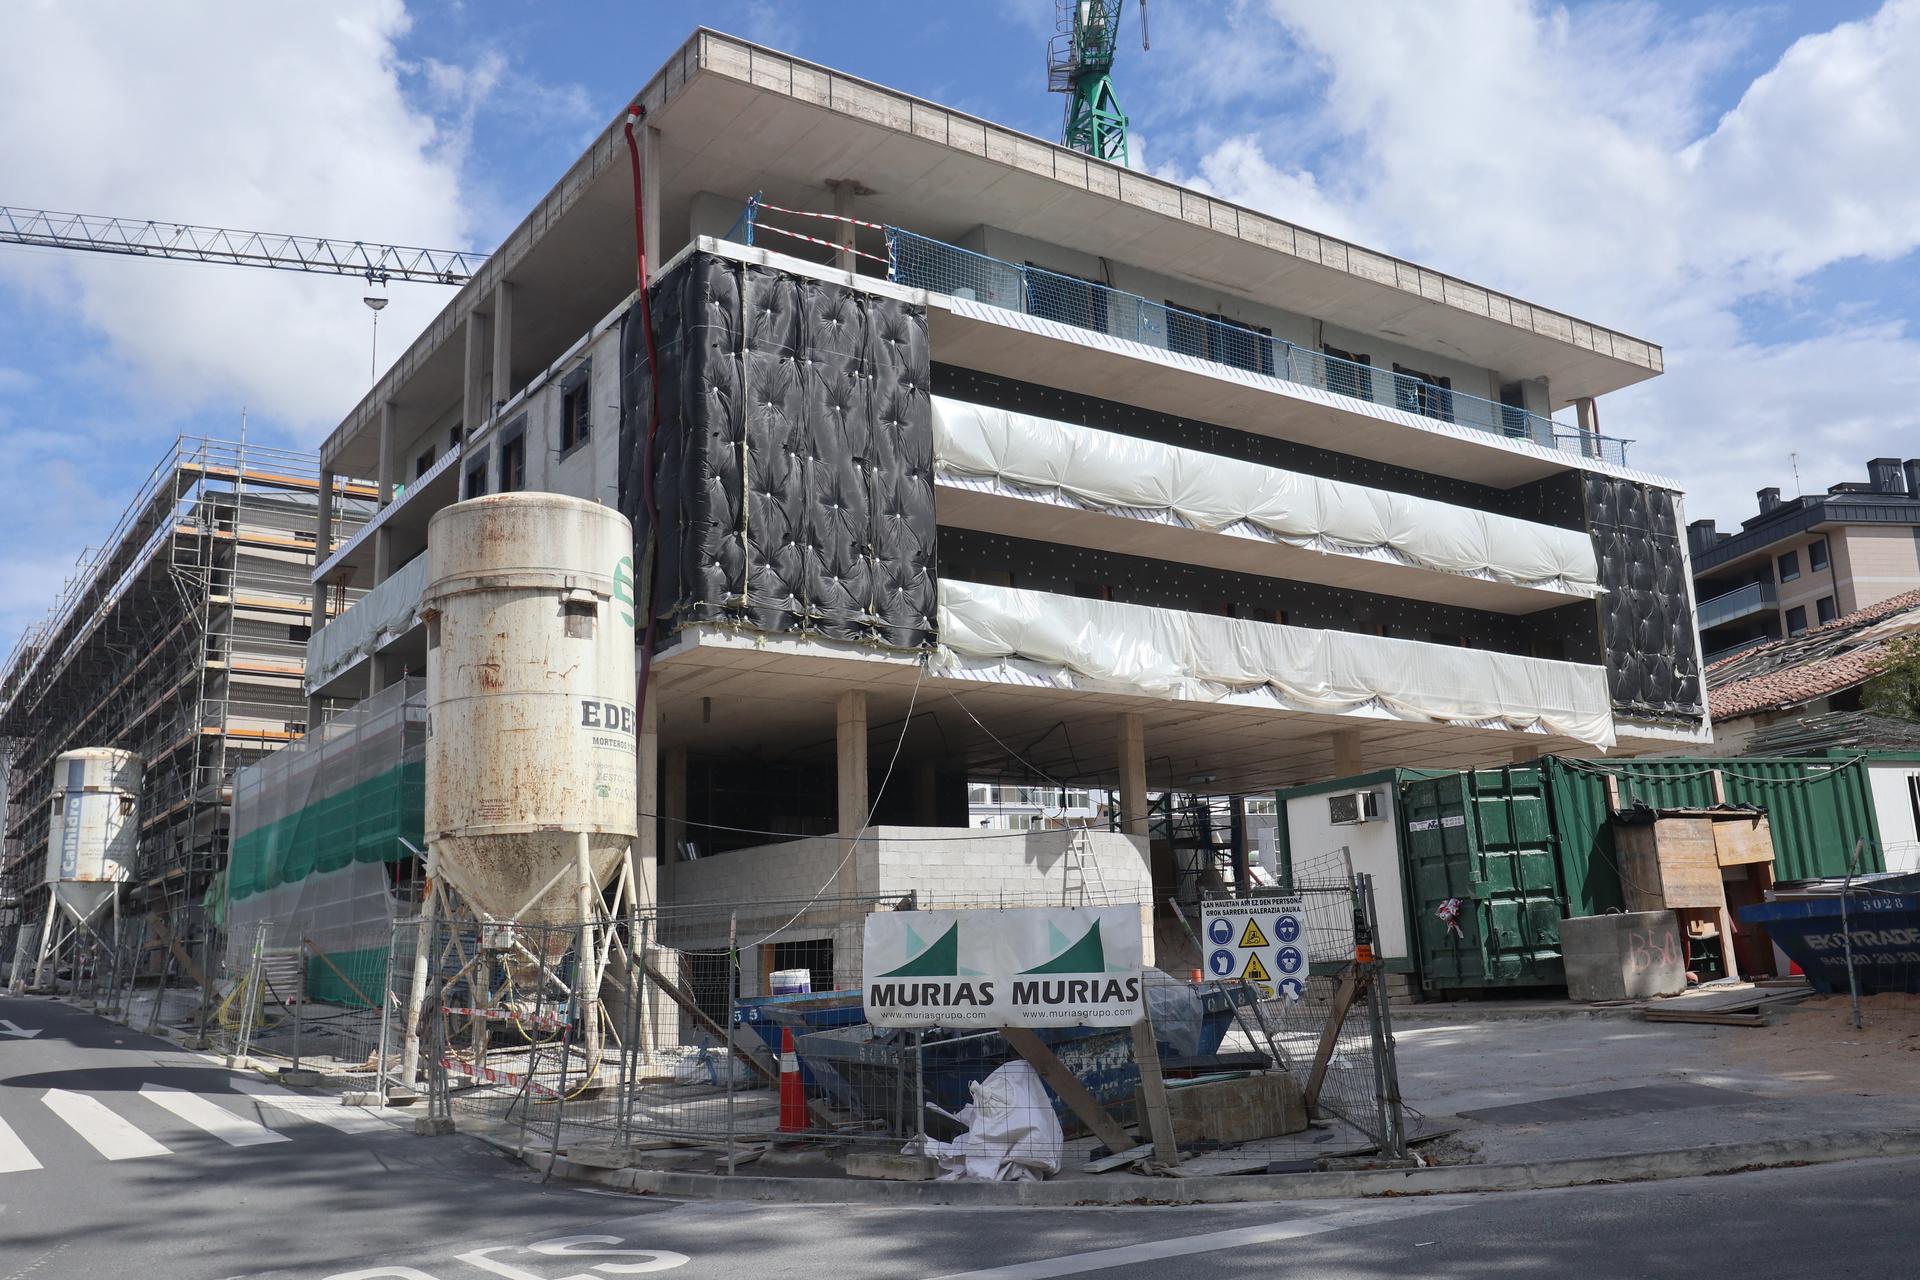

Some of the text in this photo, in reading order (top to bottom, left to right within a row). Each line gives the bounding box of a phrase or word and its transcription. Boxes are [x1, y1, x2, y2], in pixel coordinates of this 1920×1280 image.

[1862, 898, 1904, 911] 5028
[1222, 908, 1248, 916] SARRERA
[1248, 907, 1280, 915] GALERAZIA
[870, 982, 994, 1007] MURIAS
[1012, 977, 1139, 1005] MURIAS
[880, 1011, 986, 1021] www.muriasgrupo.com
[1022, 1008, 1133, 1019] www.muriasgrupo.com
